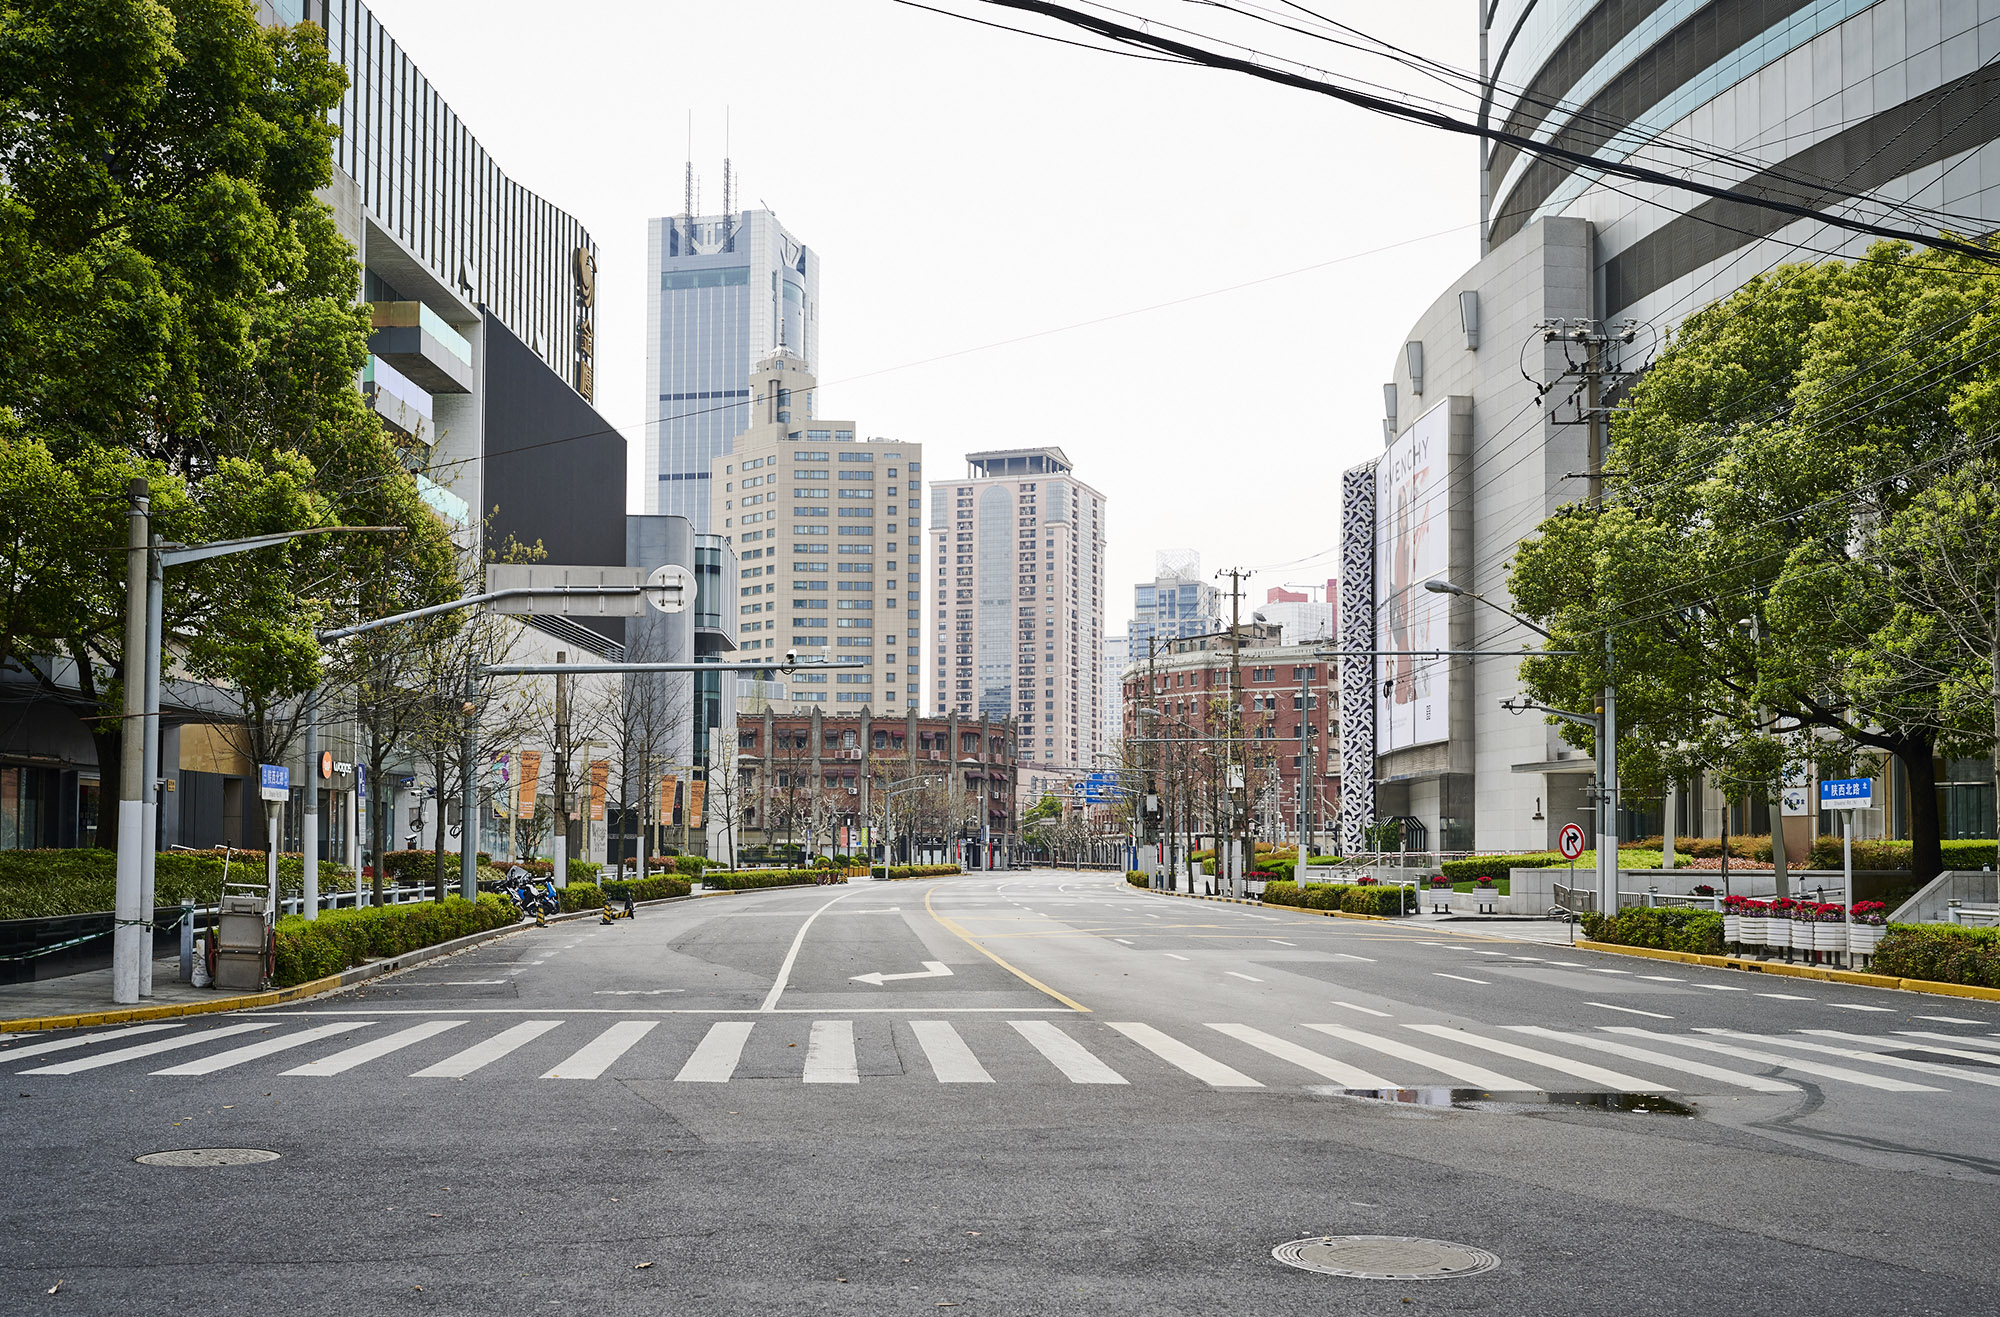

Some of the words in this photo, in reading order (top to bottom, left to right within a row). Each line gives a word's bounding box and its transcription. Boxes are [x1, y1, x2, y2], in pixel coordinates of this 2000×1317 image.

[1383, 436, 1429, 494] GVENCHY
[333, 761, 352, 778] wagas
[1831, 783, 1860, 796] 陕西北路
